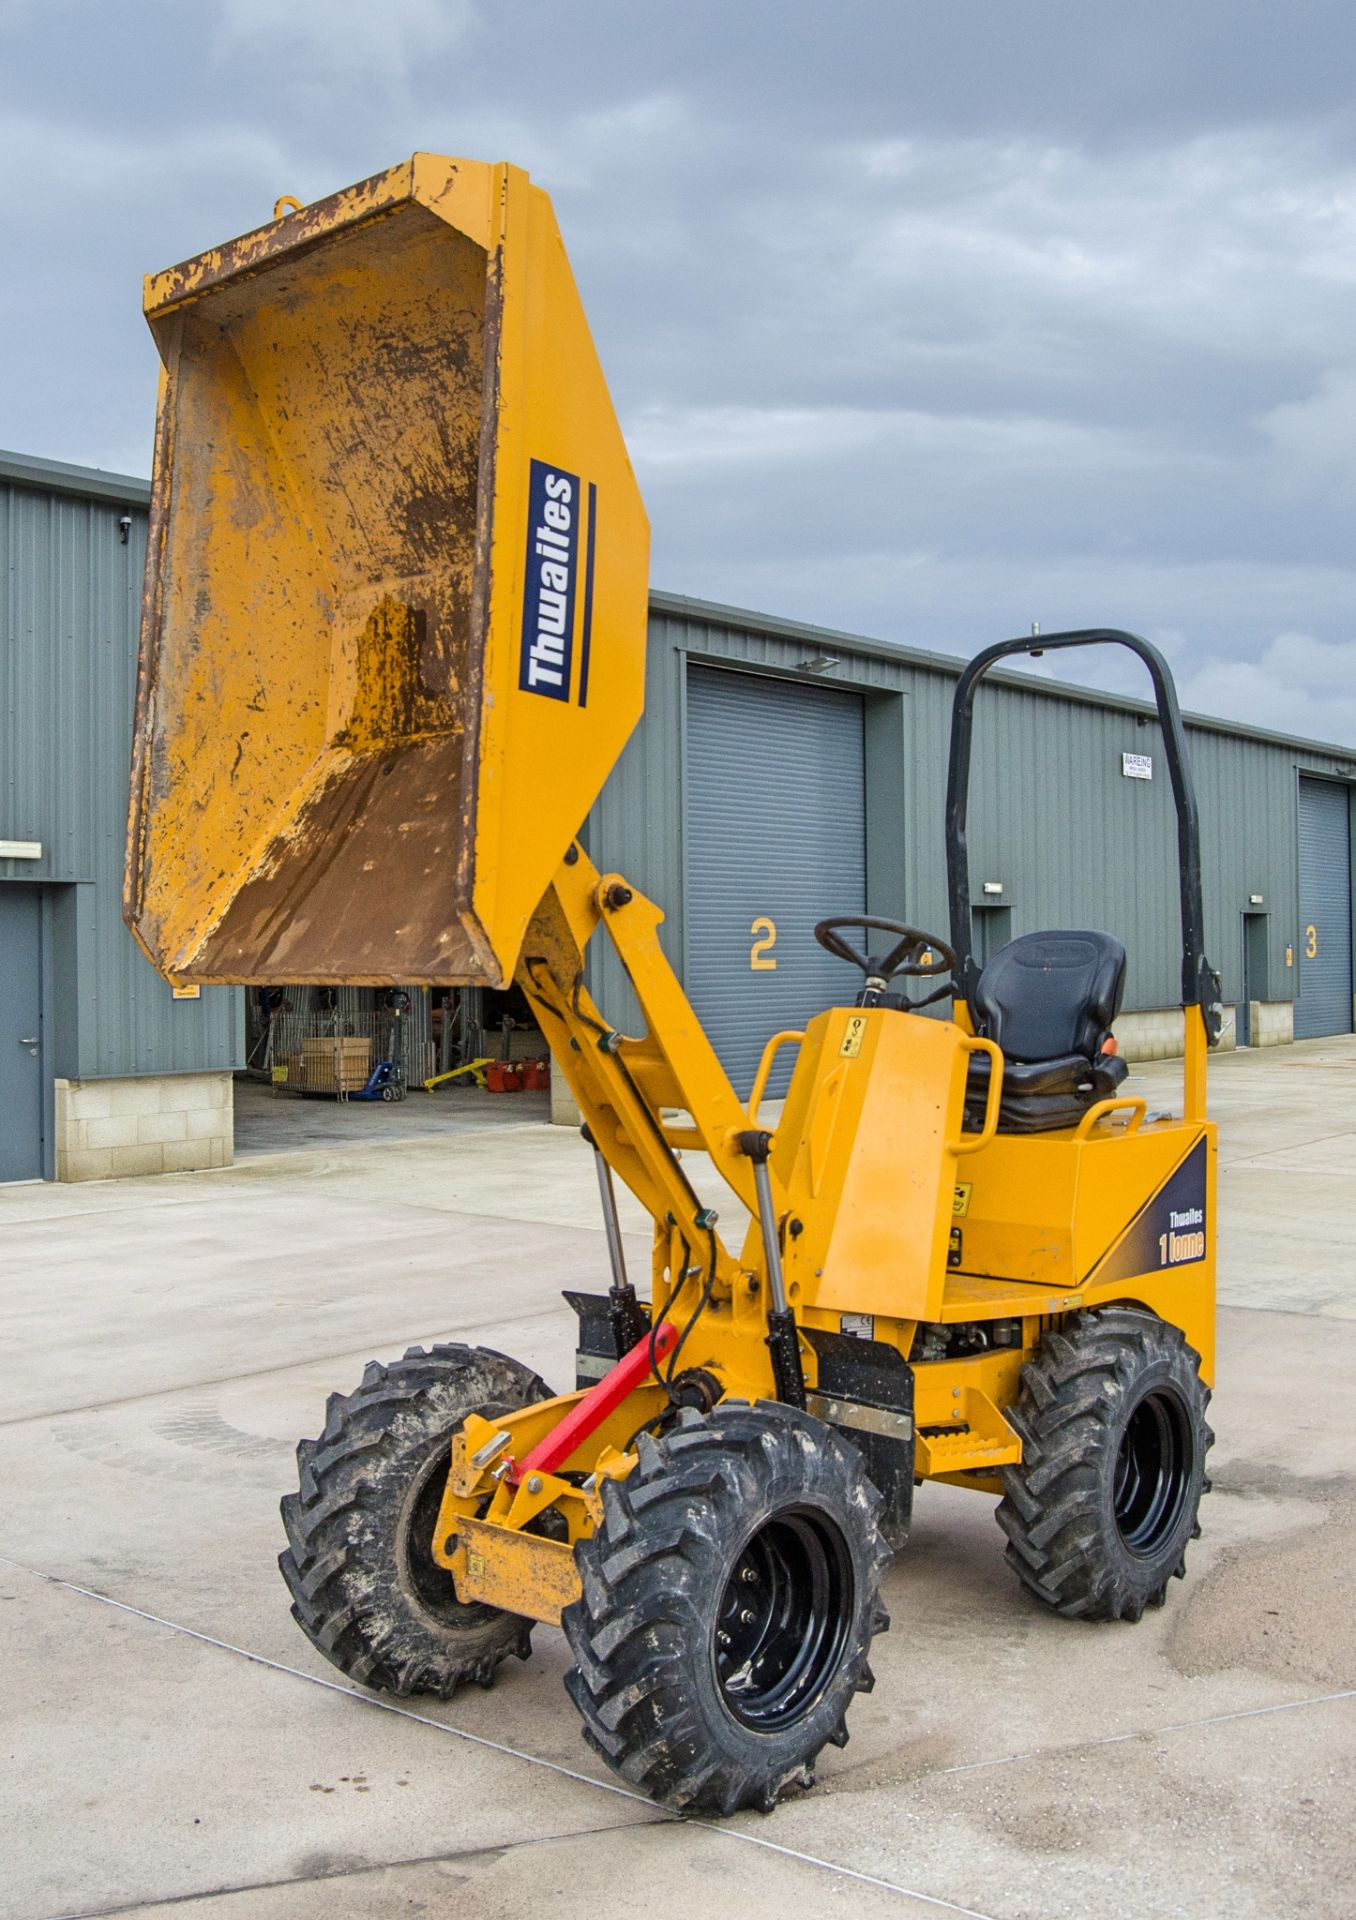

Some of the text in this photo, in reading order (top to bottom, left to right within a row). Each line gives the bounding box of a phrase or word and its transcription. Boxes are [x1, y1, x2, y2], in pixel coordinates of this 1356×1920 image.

[528, 473, 572, 686] Thwaites
[751, 916, 776, 970] 2
[1306, 925, 1316, 958] 3
[1169, 1208, 1202, 1229] Thwaites
[1159, 1231, 1204, 1265] 1 tonne
